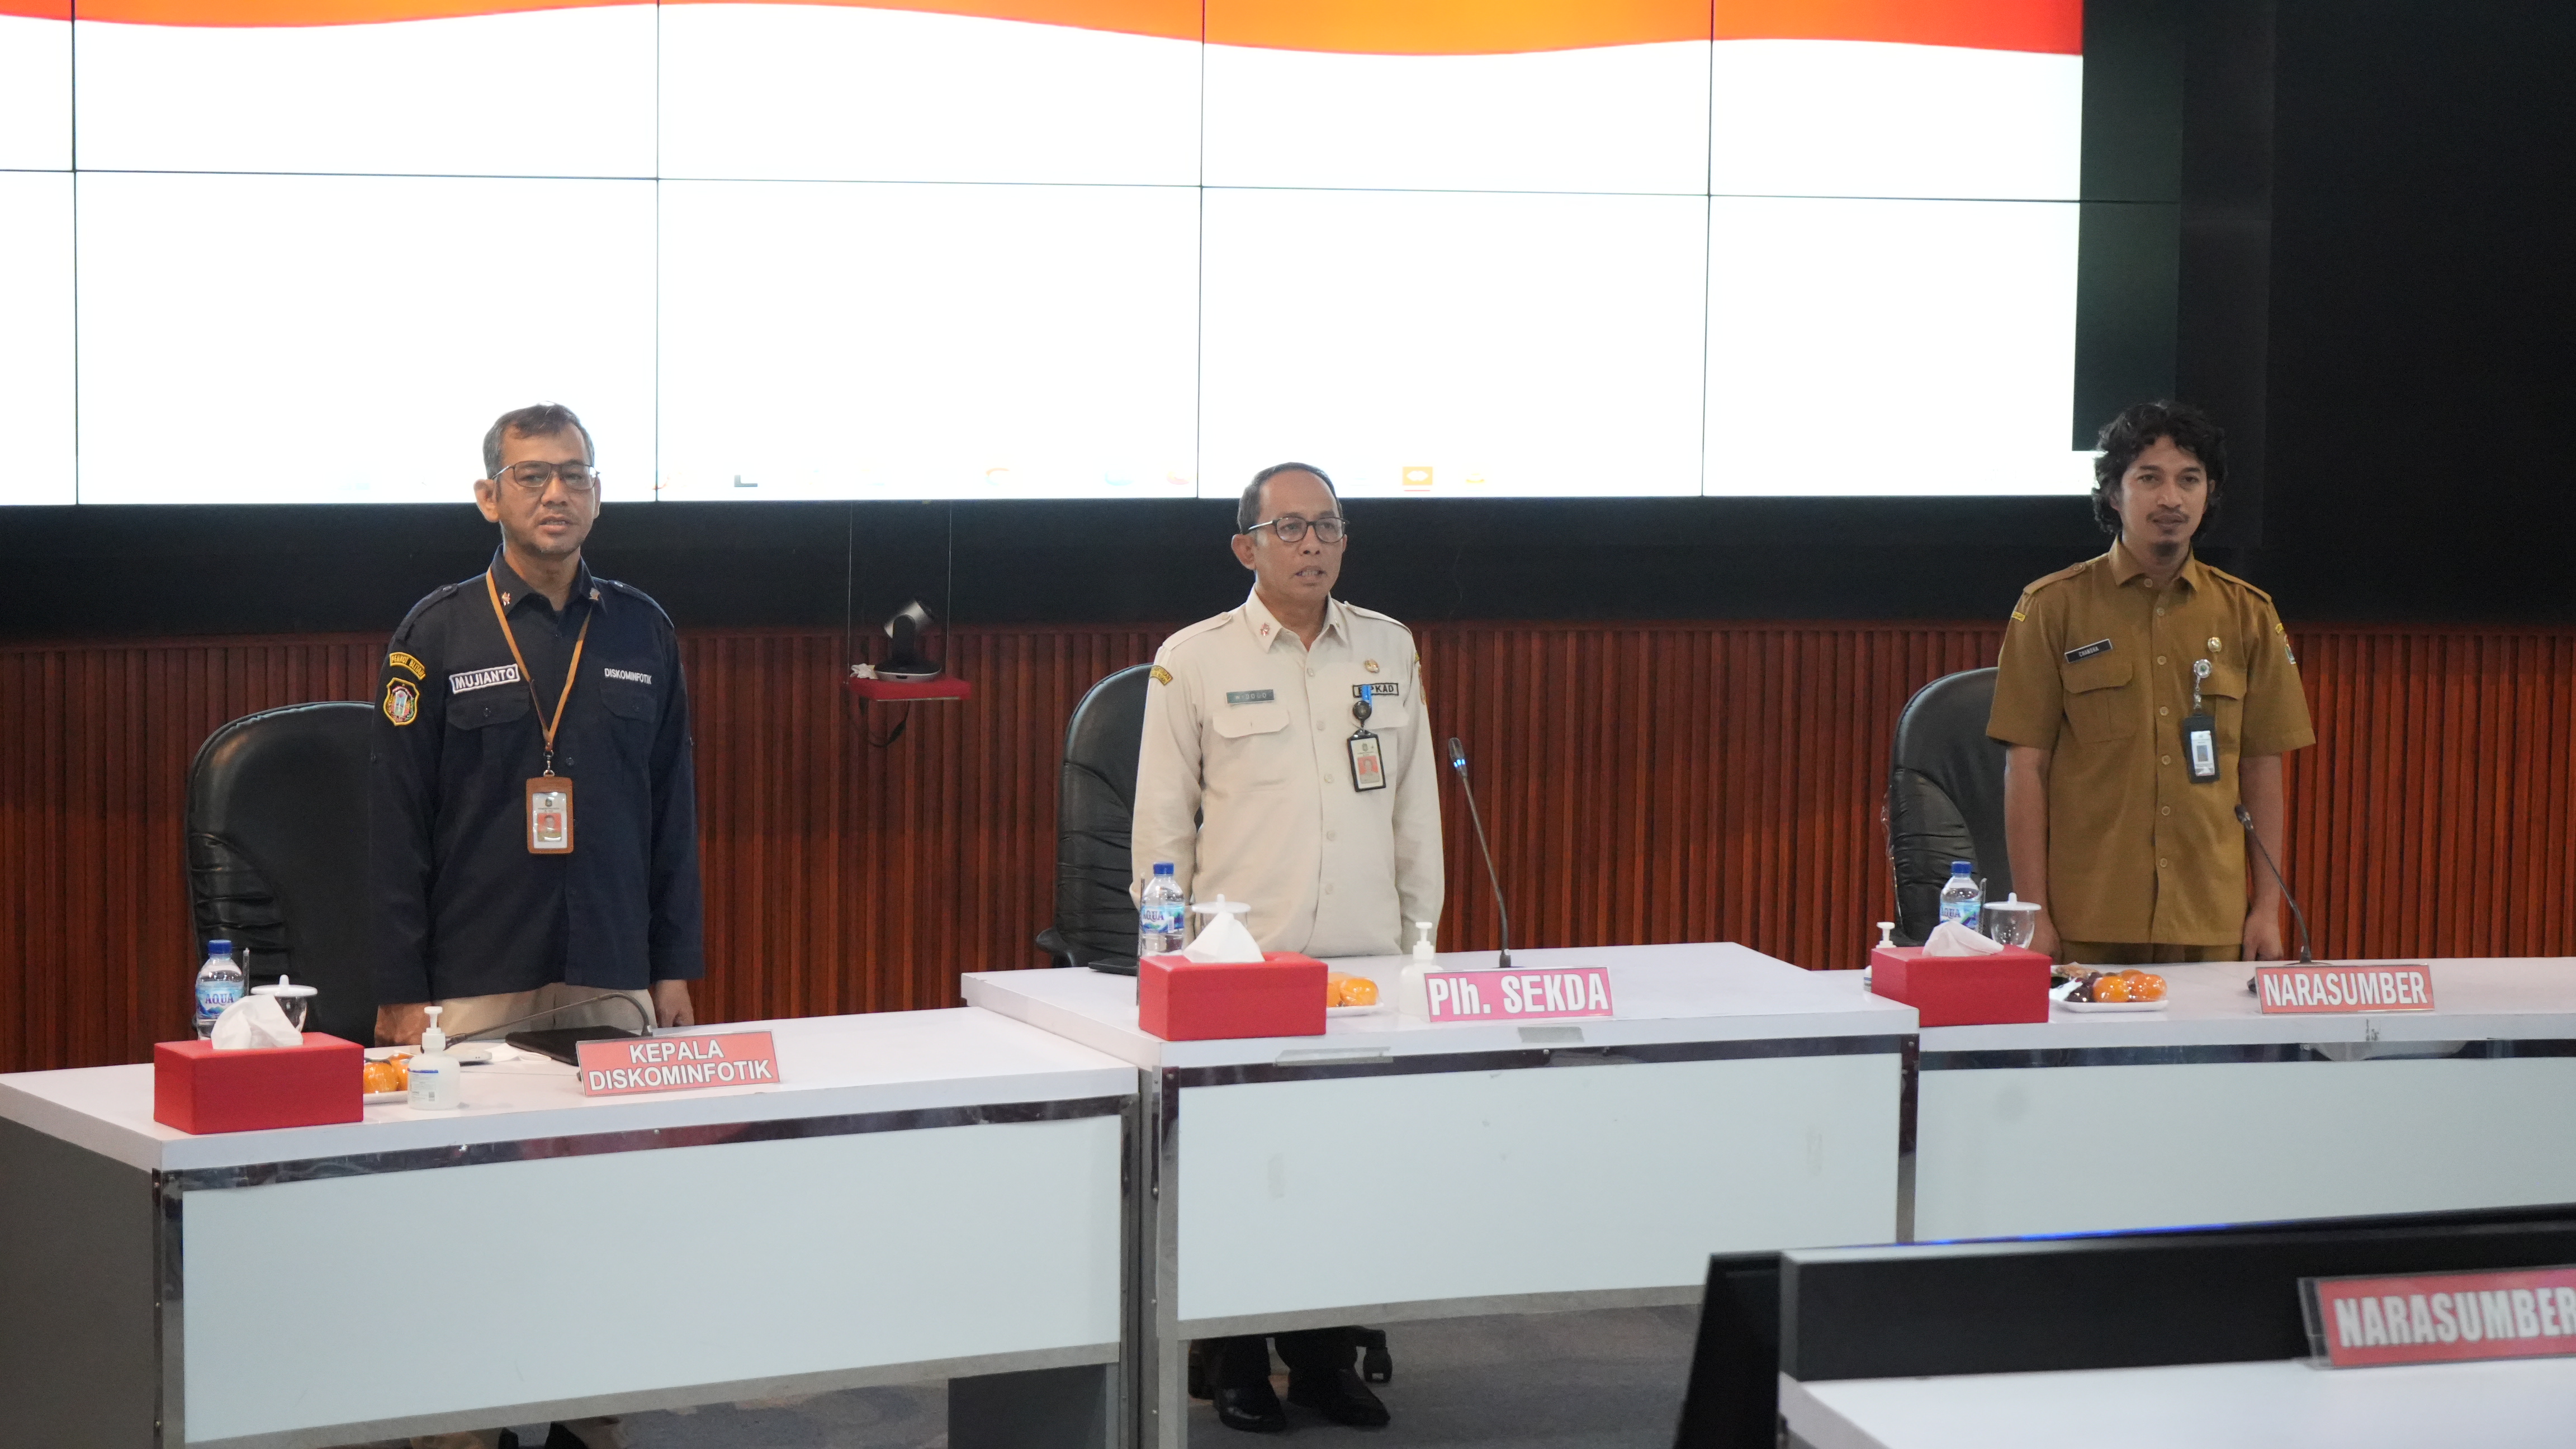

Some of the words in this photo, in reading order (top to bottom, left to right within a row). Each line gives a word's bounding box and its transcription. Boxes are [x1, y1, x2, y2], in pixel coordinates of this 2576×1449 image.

[455, 668, 515, 689] MUJIANTO
[604, 668, 652, 685] DISKOMINFOTIK
[205, 993, 234, 1006] AQUA
[1428, 977, 1491, 1016] Plh.
[1500, 973, 1609, 1014] SEKDA
[2264, 972, 2428, 1006] NARASUMBER
[629, 1039, 724, 1064] KEPALA
[588, 1059, 773, 1091] DISKOMINFOTIK
[2333, 1286, 2576, 1347] NARASUMBER
